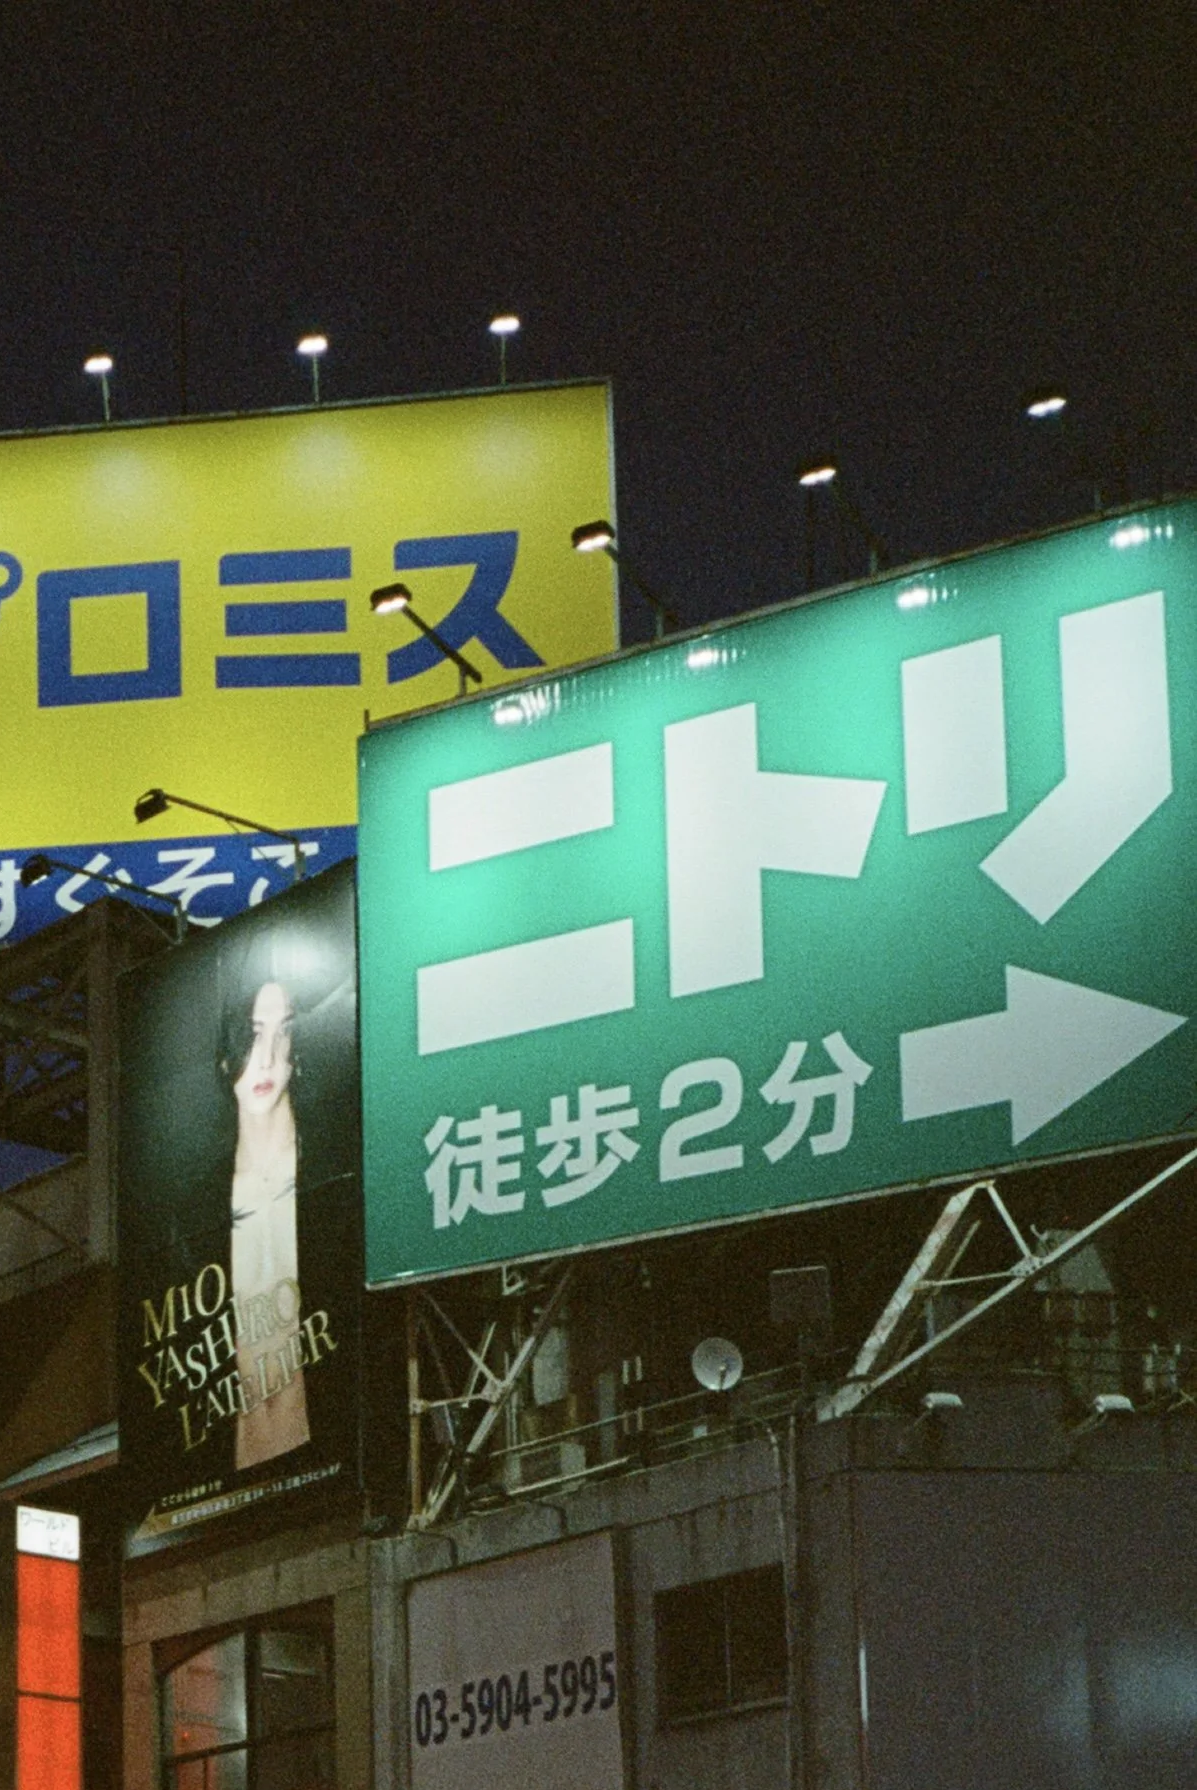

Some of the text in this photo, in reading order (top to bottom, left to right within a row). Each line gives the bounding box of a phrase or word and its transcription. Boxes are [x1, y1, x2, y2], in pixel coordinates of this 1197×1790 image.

[416, 590, 1174, 1056] ニトリ
[423, 1032, 873, 1229] 徒歩2分
[143, 1263, 227, 1348] MIO
[415, 1650, 617, 1747] 03-5904-5995
